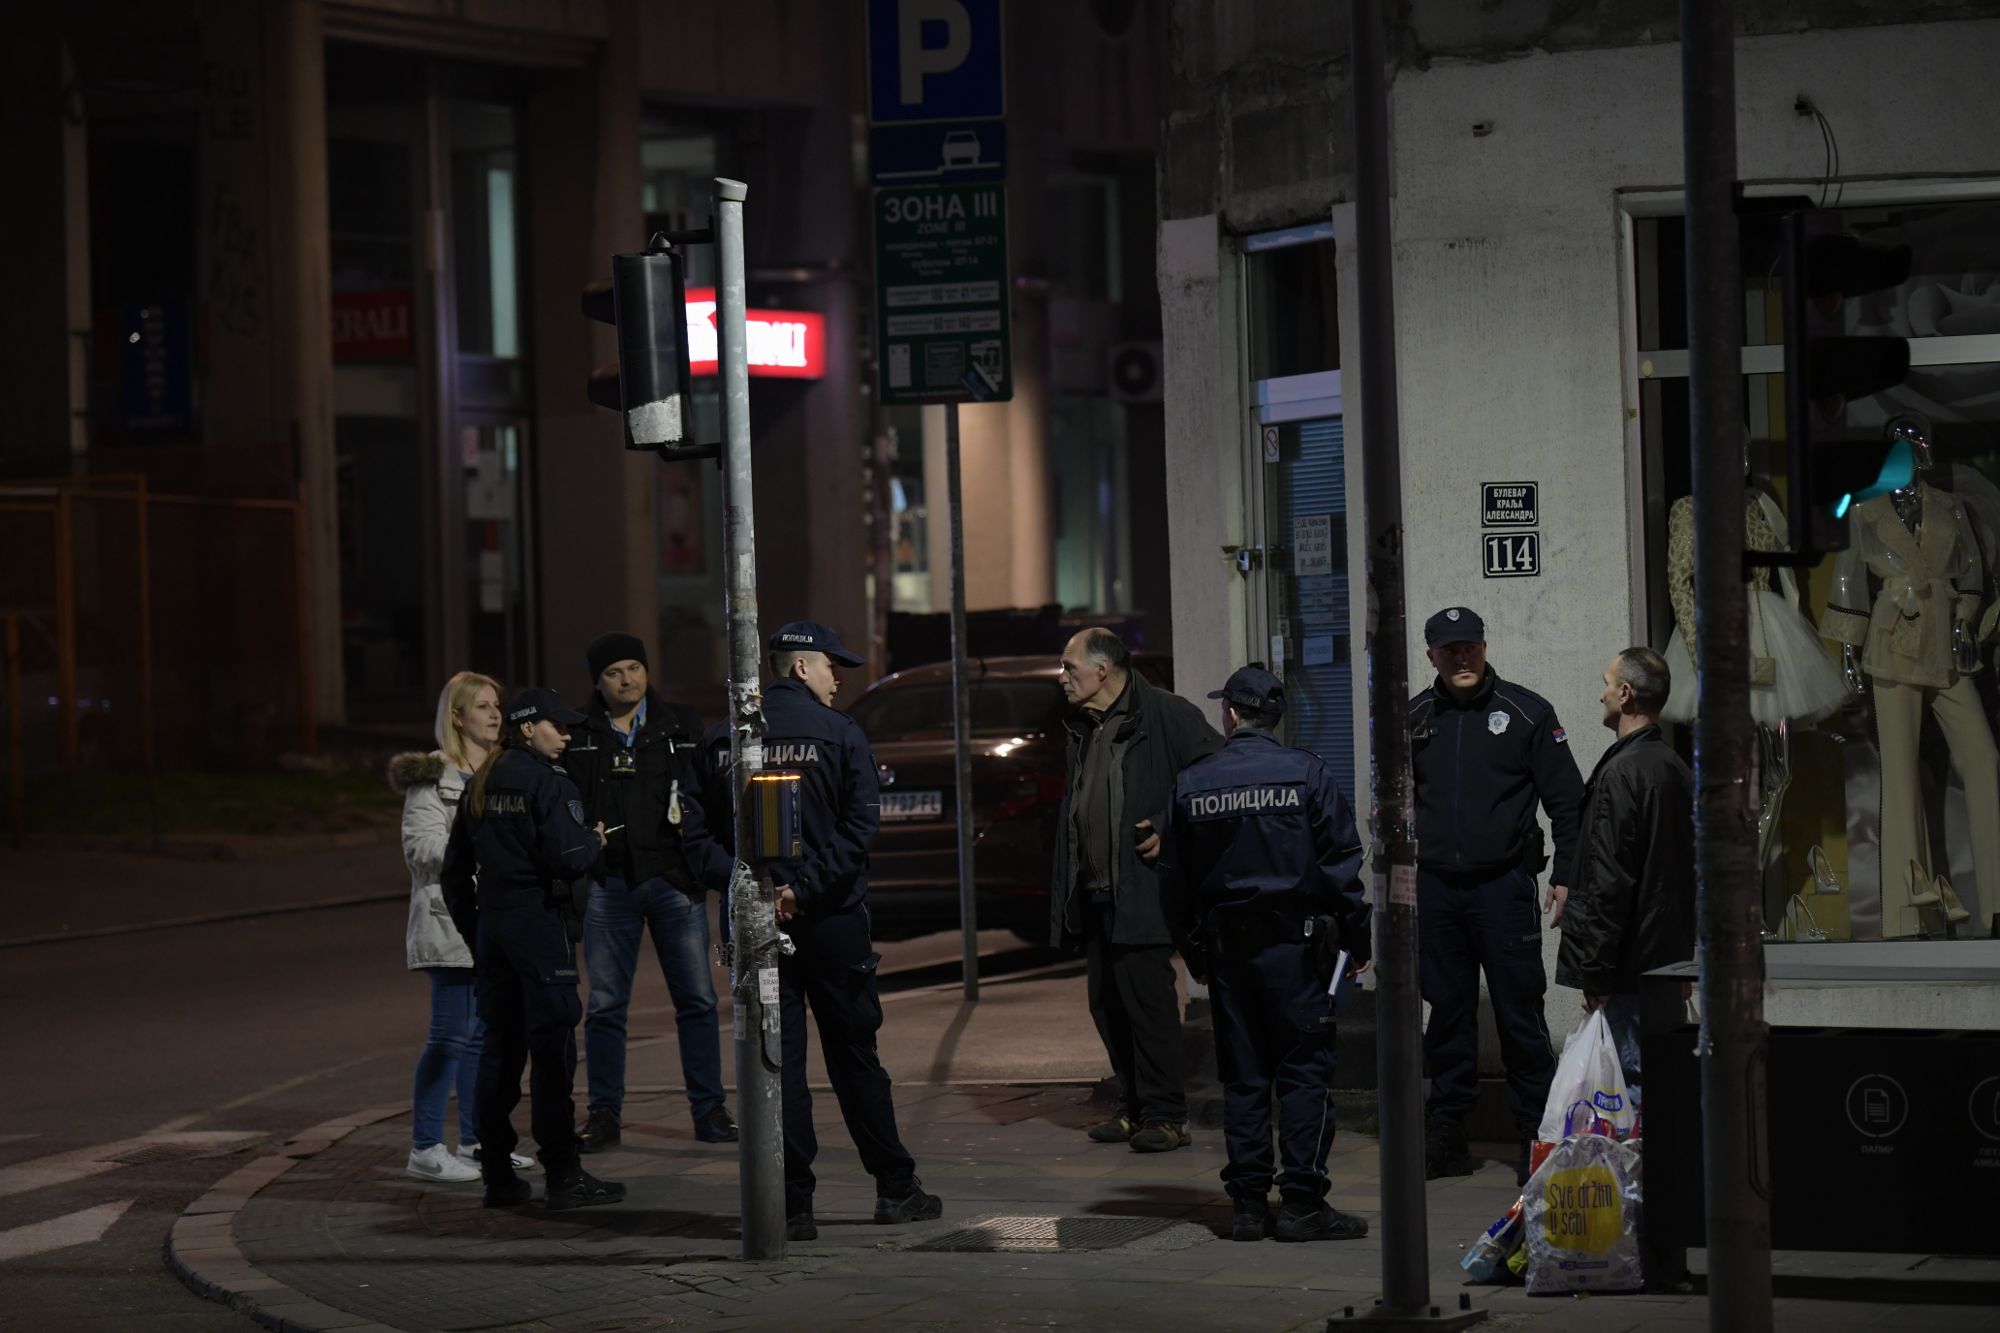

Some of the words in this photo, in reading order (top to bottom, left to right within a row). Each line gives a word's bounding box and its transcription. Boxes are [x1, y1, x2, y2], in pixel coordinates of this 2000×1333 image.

[898, 0, 972, 106] P
[884, 193, 966, 223] ЗОНА
[974, 191, 997, 217] III
[1493, 488, 1526, 498] БУЛЕВАР
[1496, 499, 1523, 509] КРАЉА
[1486, 510, 1534, 521] АЛЕКСАНДРА
[1488, 536, 1533, 572] 114
[718, 744, 819, 767] ПИЦИЈА
[1191, 788, 1300, 816] ПОЛИЦИЈА
[1861, 1145, 1895, 1155] ПАПИР
[1549, 1184, 1574, 1209] Sve
[1577, 1180, 1613, 1209] držim
[1550, 1211, 1558, 1236] u
[1561, 1211, 1587, 1236] sebi
